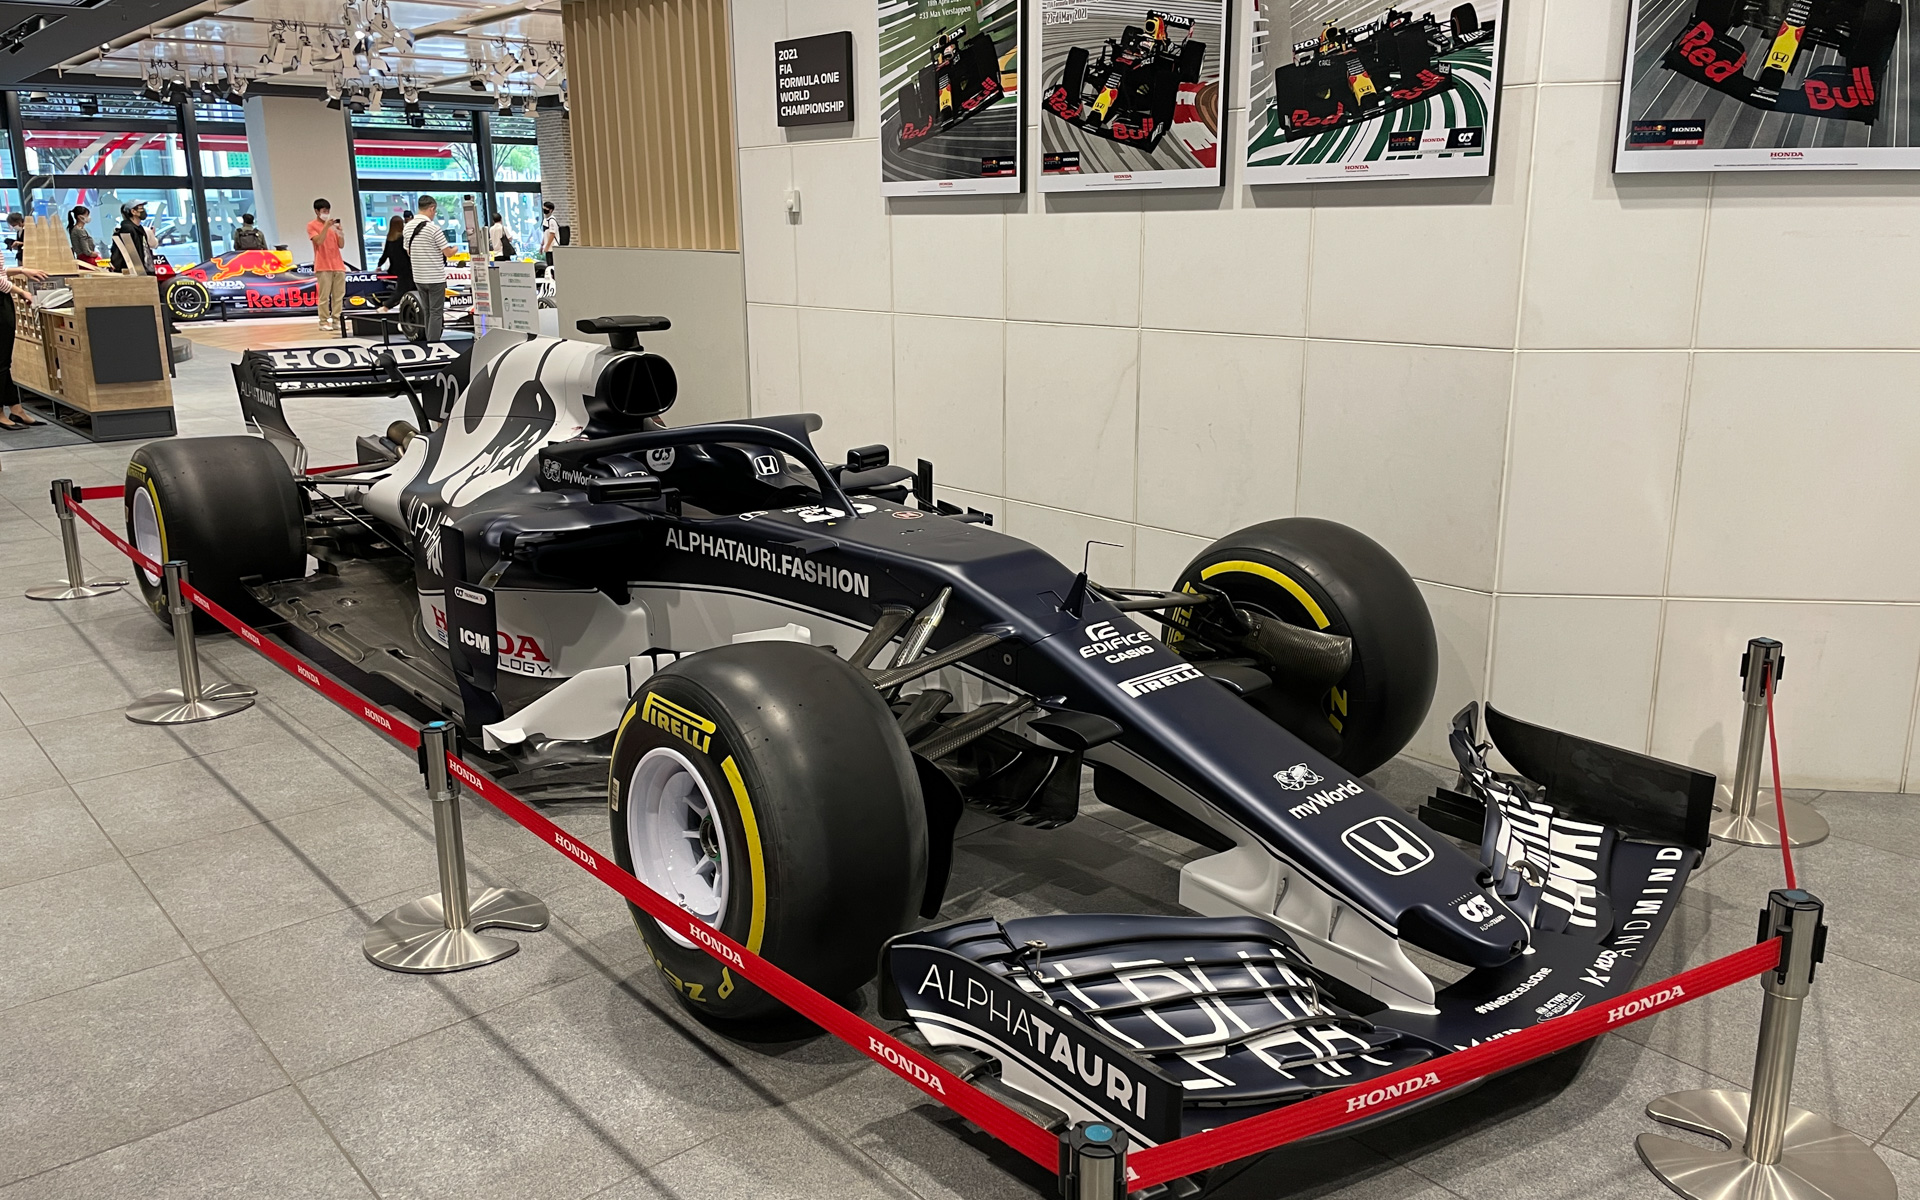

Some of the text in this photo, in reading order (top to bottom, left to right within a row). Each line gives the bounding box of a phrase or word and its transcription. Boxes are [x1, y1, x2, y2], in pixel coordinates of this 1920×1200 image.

[942, 6, 971, 16] Verstappen
[1074, 8, 1087, 20] 2021
[778, 48, 798, 61] 2021
[1679, 20, 1875, 109] Red Bull
[779, 63, 793, 75] FIA
[779, 71, 840, 89] FORMULA ONE
[780, 90, 810, 103] WORLD
[780, 100, 845, 117] CHAMPIONSHIP
[1112, 118, 1154, 139] Bull
[345, 274, 377, 282] RACLE
[246, 289, 286, 308] Red
[450, 296, 472, 305] Mobil
[267, 342, 461, 370] HONDA
[665, 527, 870, 598] ALPHATAURI.FASHION
[193, 593, 210, 610] HONDA
[241, 627, 260, 646] HONDA
[459, 627, 490, 651] ICM
[1079, 631, 1153, 659] EDIFICE
[1104, 645, 1155, 664] CASIO
[297, 665, 320, 686] HONDA
[1116, 662, 1205, 699] PIRELLI
[364, 707, 392, 730] HONDA
[642, 691, 717, 754] PIRELLI
[447, 757, 484, 791] HONDA
[1288, 780, 1364, 820] myWorld
[554, 832, 599, 870] HONDA
[689, 922, 745, 970] HONDA
[1475, 967, 1553, 1015] #WeRaceAsOne
[1544, 992, 1569, 1010] ACTION
[1607, 985, 1686, 1024] HONDA
[917, 963, 1147, 1120] ALPHATAURI
[868, 1035, 946, 1096] HONDA
[1345, 1072, 1441, 1114] HONDA
